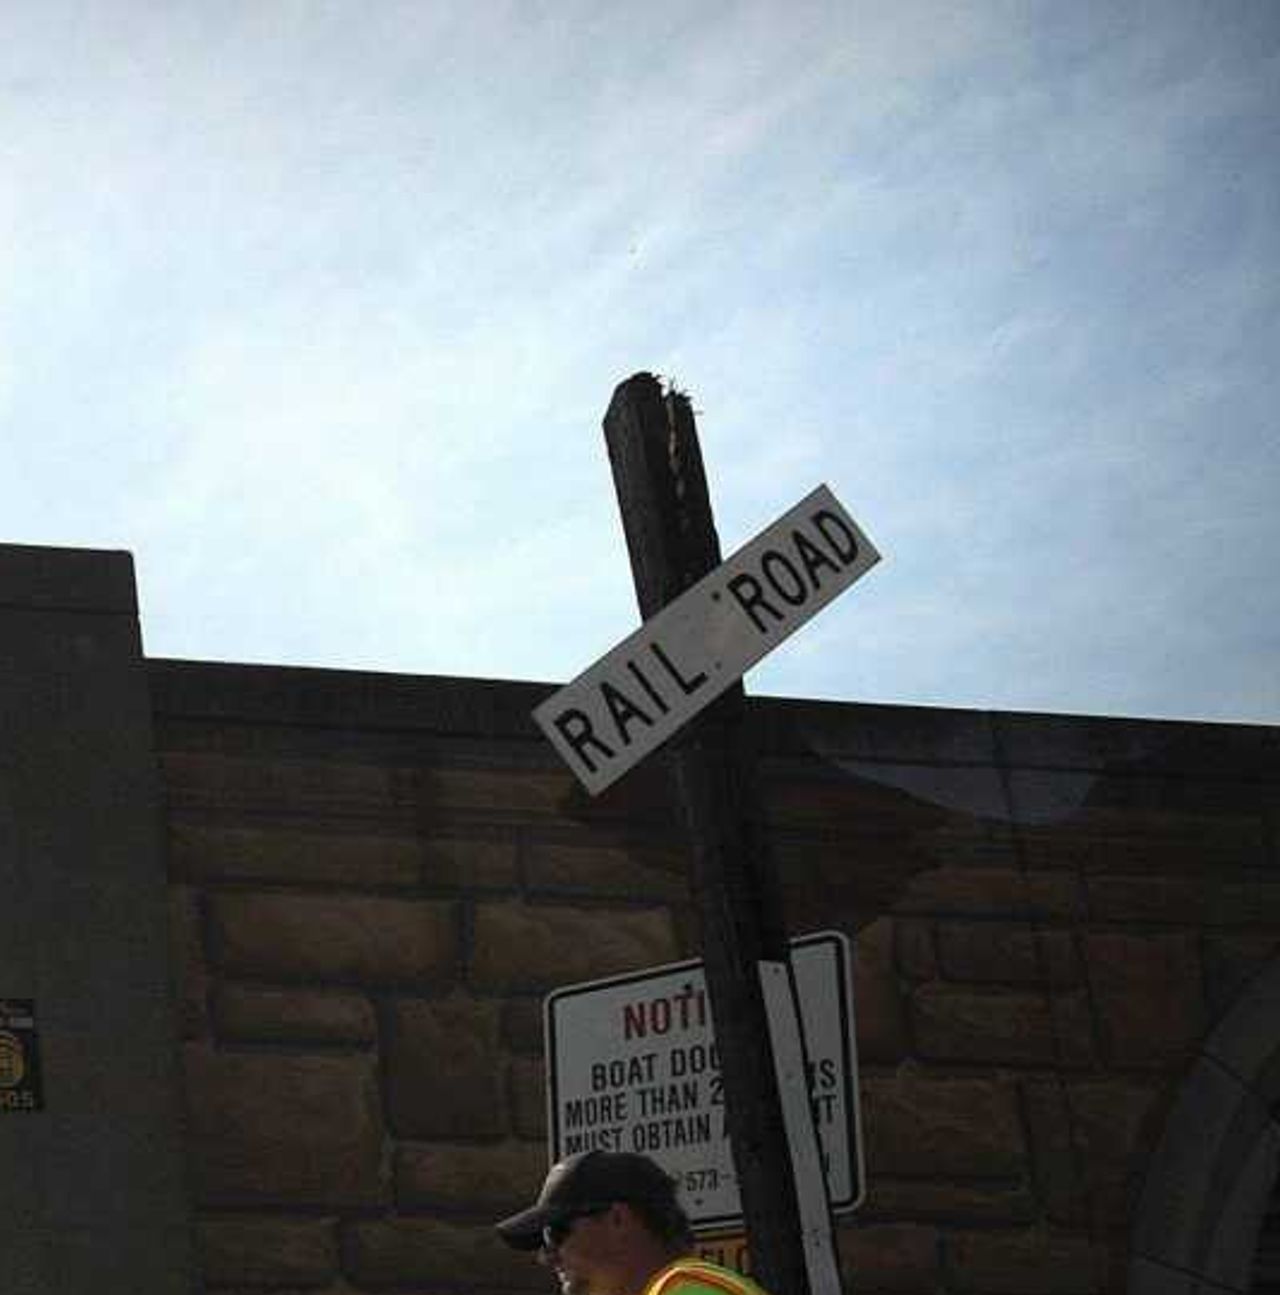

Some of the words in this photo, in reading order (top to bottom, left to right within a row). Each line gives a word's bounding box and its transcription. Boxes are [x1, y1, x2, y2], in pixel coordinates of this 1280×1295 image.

[553, 642, 708, 774] RAIL
[726, 508, 858, 635] ROAD
[624, 989, 705, 1040] NOTI
[591, 1053, 657, 1091] BOAT
[566, 1092, 628, 1128] MORE
[636, 1081, 697, 1117] THAN
[566, 1127, 622, 1156] MUST
[633, 1113, 710, 1153] OBTAIN
